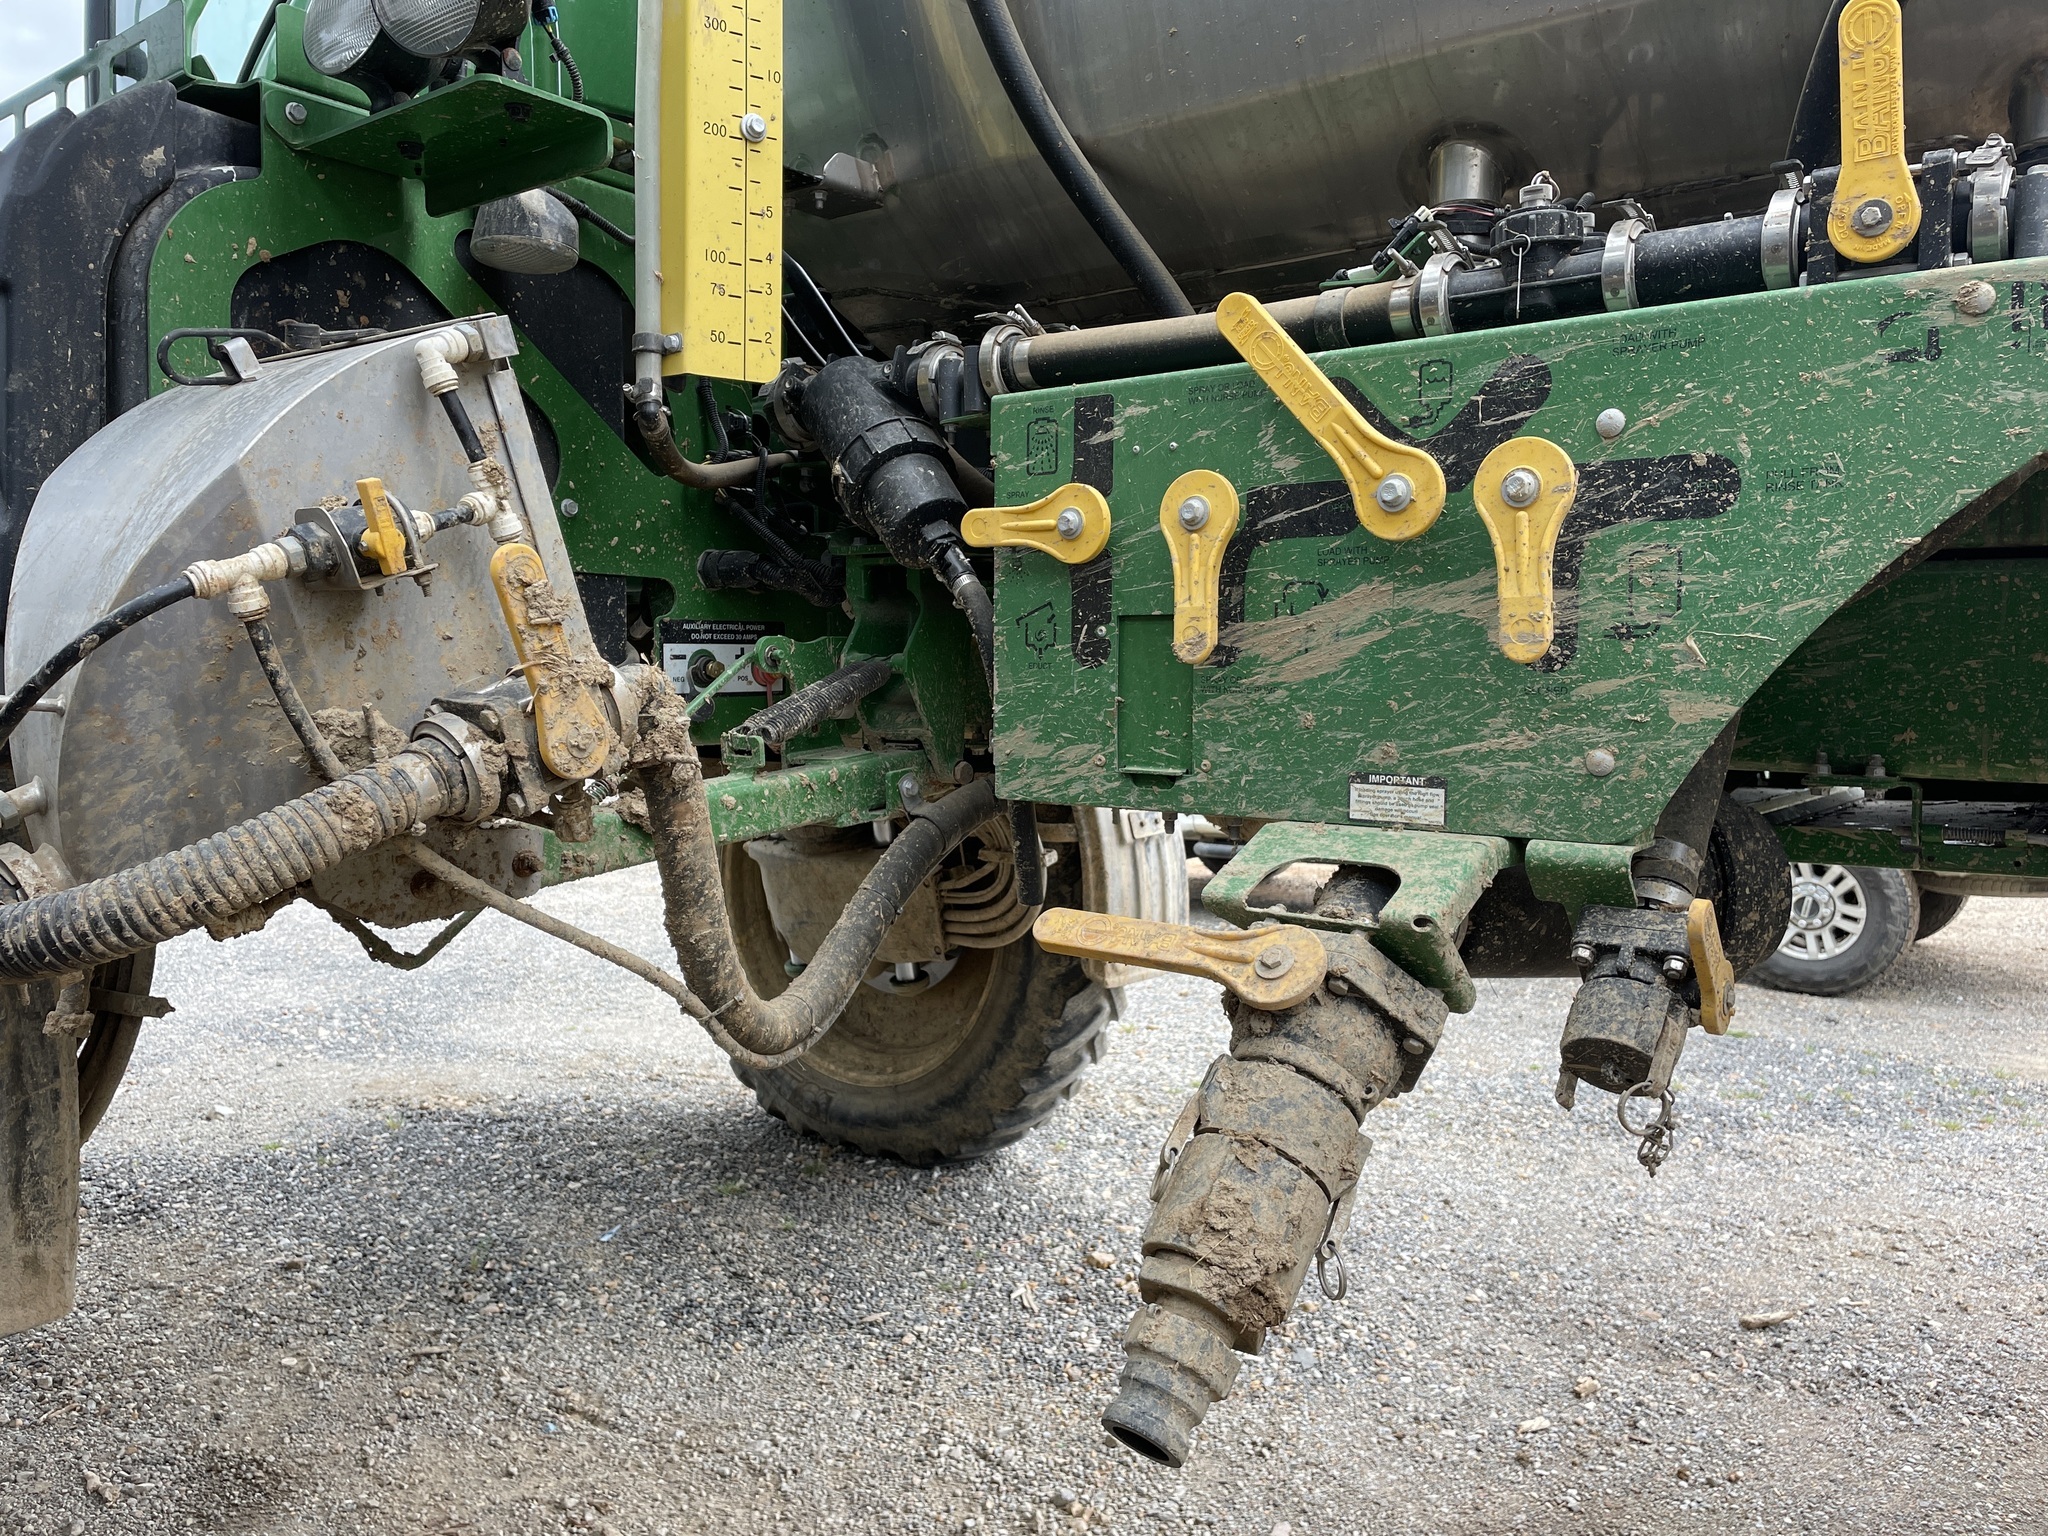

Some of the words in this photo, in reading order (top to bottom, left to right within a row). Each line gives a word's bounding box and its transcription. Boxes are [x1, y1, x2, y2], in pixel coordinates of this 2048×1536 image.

[704, 17, 727, 33] 300
[767, 70, 782, 84] 10
[703, 122, 727, 138] 200
[765, 206, 773, 219] 5
[1895, 195, 1907, 230] OPEN
[704, 249, 727, 264] 100
[765, 253, 773, 265] 4
[710, 283, 726, 296] 75
[765, 283, 773, 296] 3
[710, 331, 726, 345] 50
[764, 332, 772, 345] 2
[1649, 328, 1677, 340] WITH
[1612, 342, 1667, 357] SPRAYER
[1671, 336, 1706, 349] PUMP
[1188, 384, 1215, 395] SPRAY
[1217, 382, 1230, 392] OR
[1233, 380, 1256, 390] LOAD
[1212, 392, 1239, 402] NURSE
[1242, 388, 1267, 399] PUMP
[1033, 405, 1055, 414] RINSE
[1766, 468, 1797, 479] PULL
[1692, 480, 1724, 491] OPEN
[1765, 481, 1804, 493] RINSE
[1006, 491, 1030, 499] SPRAY
[1317, 547, 1341, 556] LOAD
[1344, 546, 1368, 555] WITH
[1317, 557, 1360, 567] SPRAYER
[1363, 555, 1390, 565] PUMP
[682, 623, 711, 631] AUXILIARY
[712, 623, 745, 631] ELECTRICAL
[1028, 662, 1052, 670] EDUCT
[1369, 774, 1425, 785] IMPORTANT
